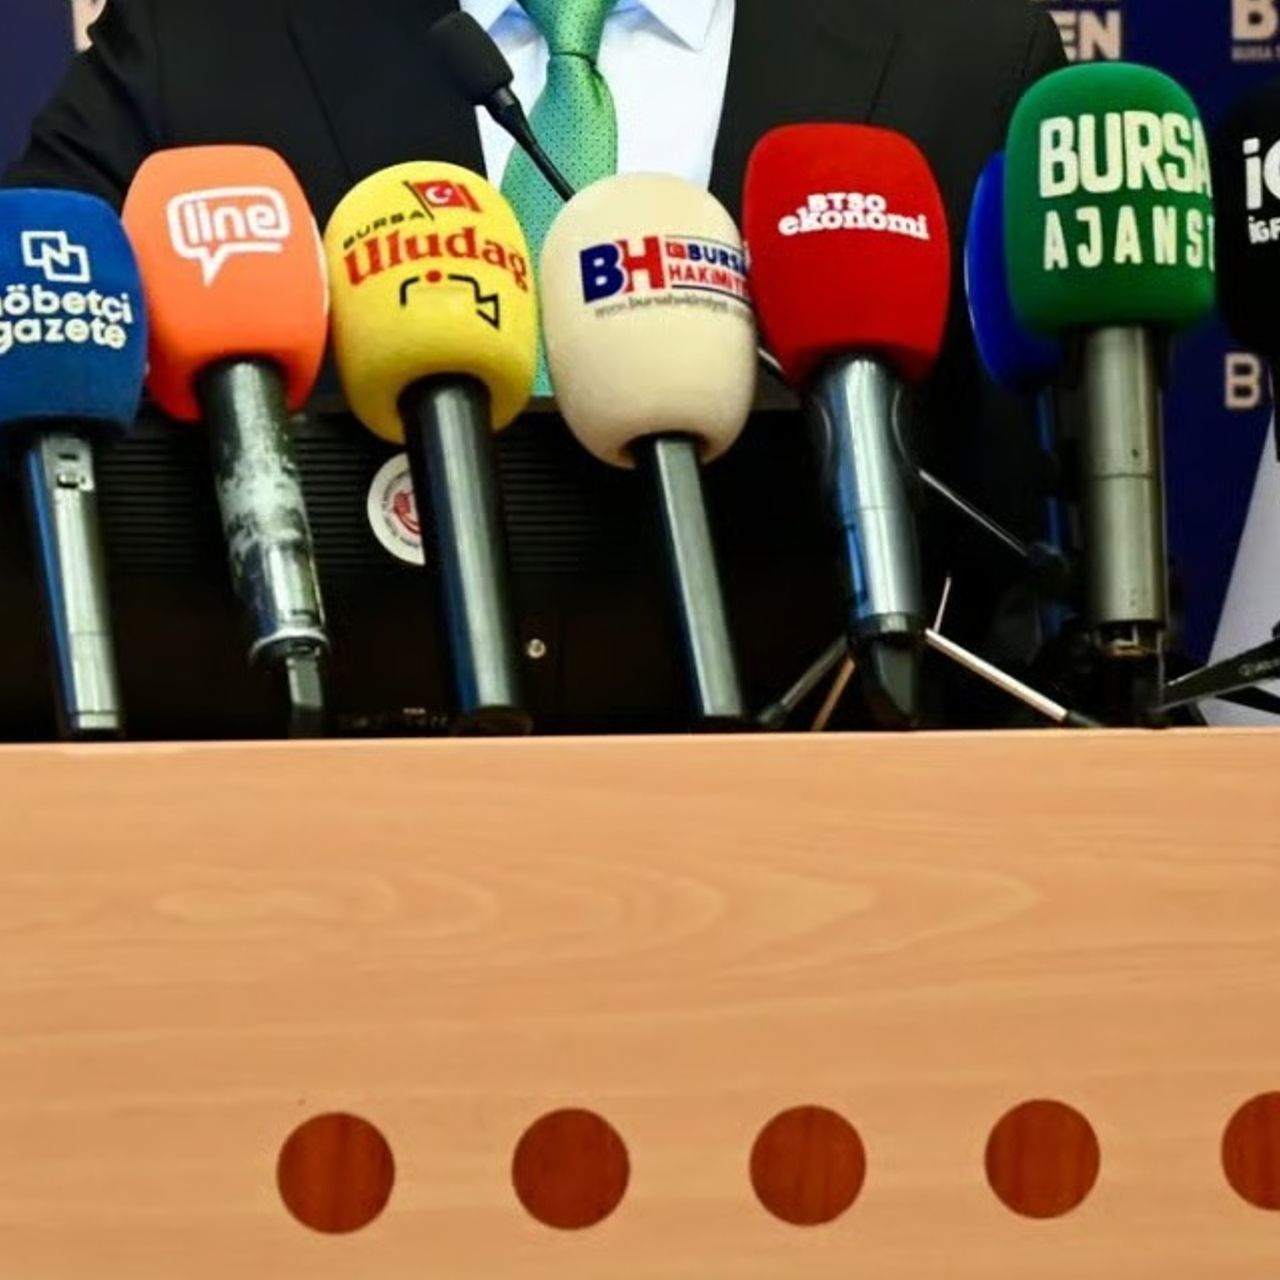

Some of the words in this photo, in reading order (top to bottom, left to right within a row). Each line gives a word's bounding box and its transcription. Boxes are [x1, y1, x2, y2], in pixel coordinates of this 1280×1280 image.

[1039, 110, 1213, 199] BURSA
[183, 201, 282, 245] line
[778, 206, 930, 241] ekonomi
[807, 192, 887, 212] BTSO
[579, 234, 666, 304] BH
